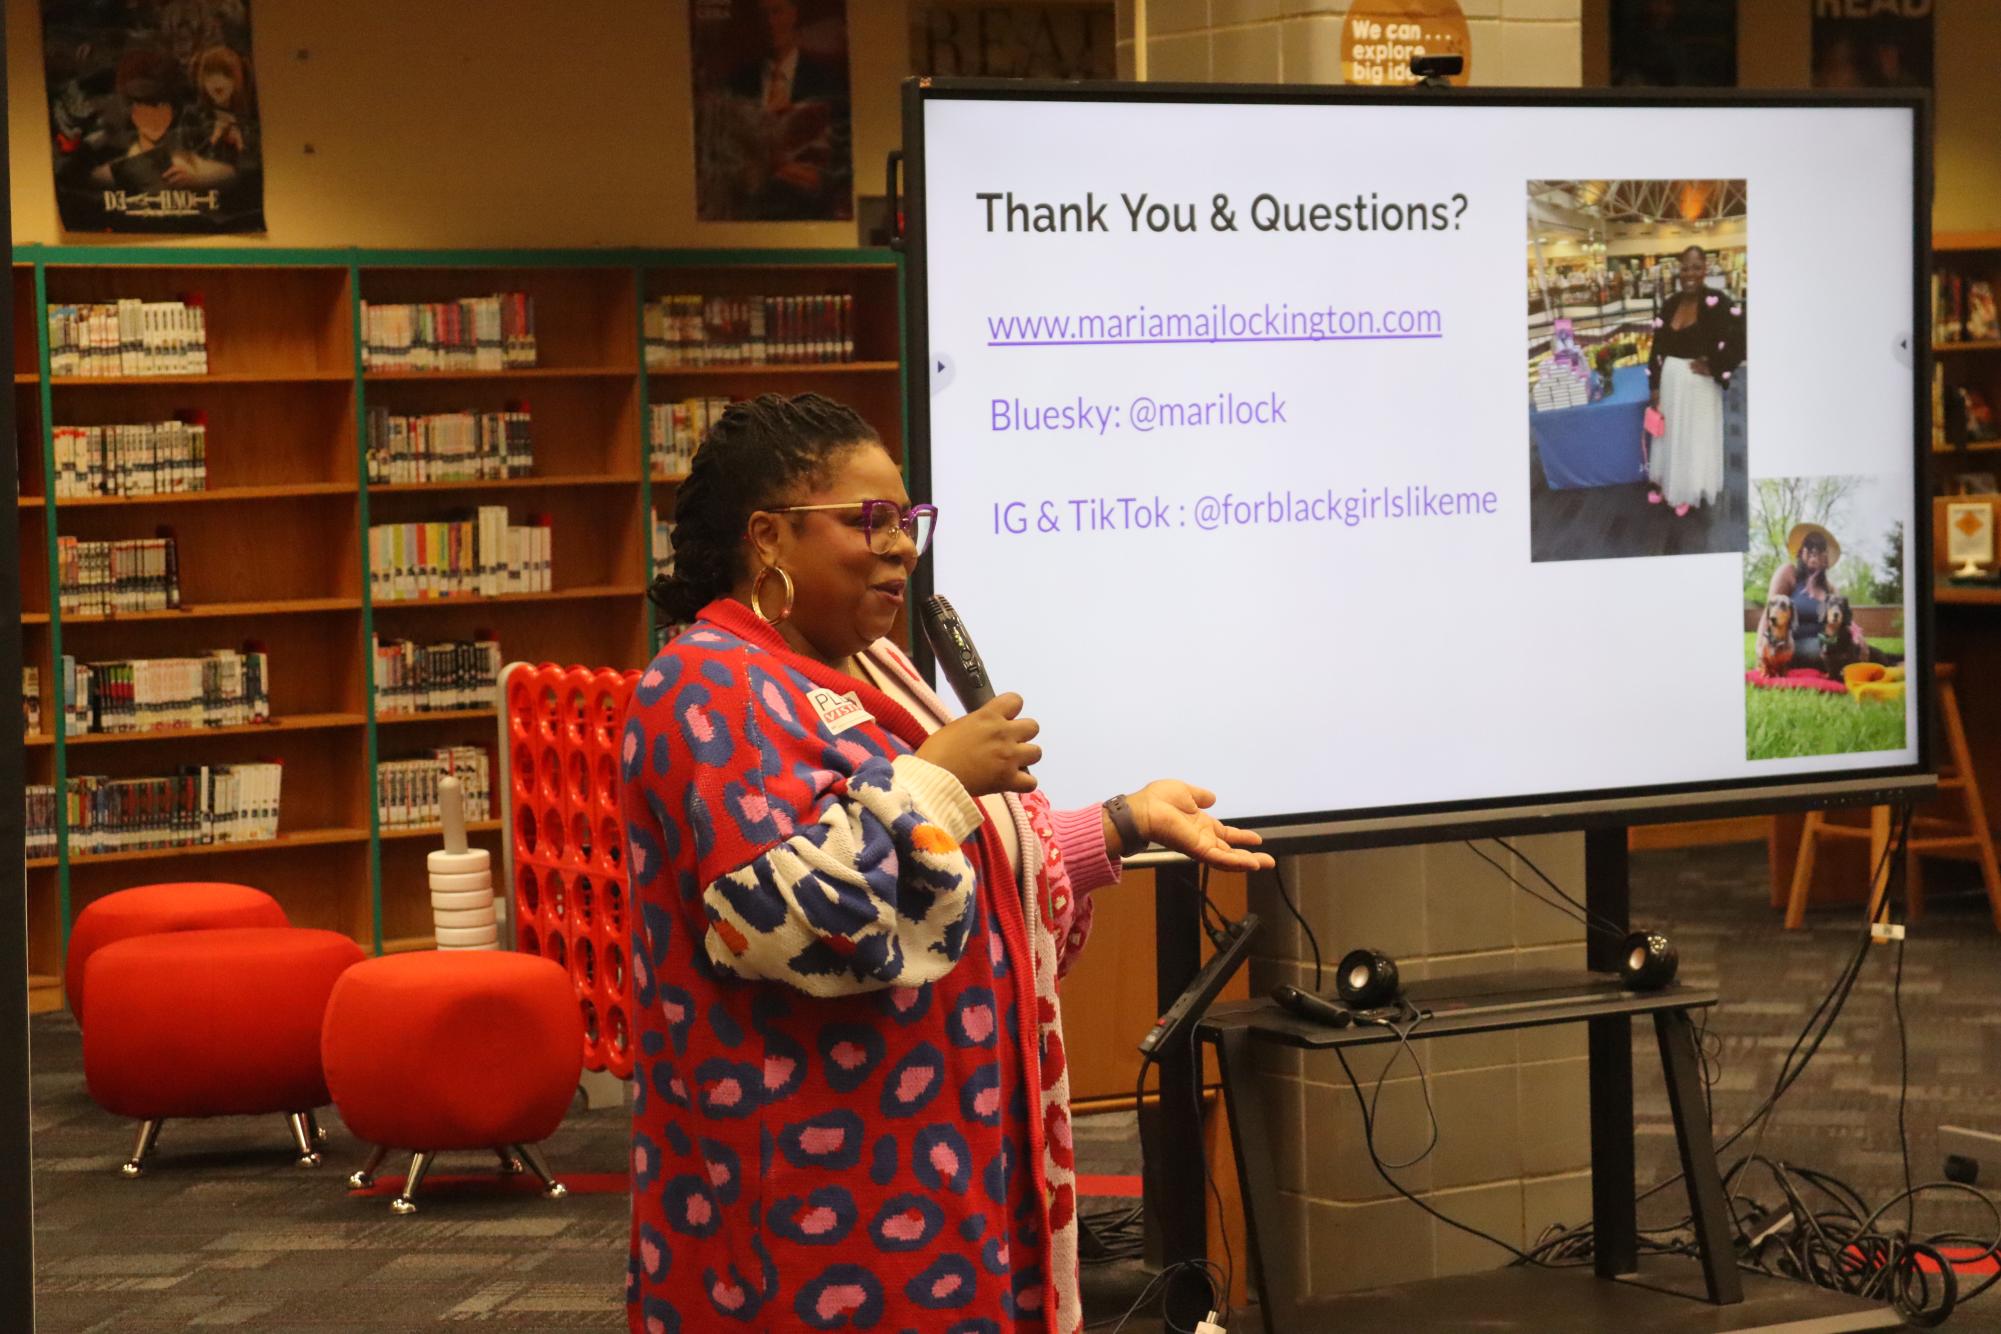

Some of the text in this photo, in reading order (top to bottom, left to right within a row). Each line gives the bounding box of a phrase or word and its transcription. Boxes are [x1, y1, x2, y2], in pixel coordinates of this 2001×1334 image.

[1352, 19, 1382, 40] We
[1352, 41, 1425, 63] explore
[1352, 61, 1383, 85] big
[976, 192, 1469, 233] Thank You & Questions?
[987, 303, 1443, 343] www.mariamajlockington.com
[991, 392, 1286, 435] Bluesky: @marilock
[994, 502, 1027, 534] IG
[1037, 501, 1060, 532] &
[1195, 486, 1498, 530] @forblackgirlslikeme
